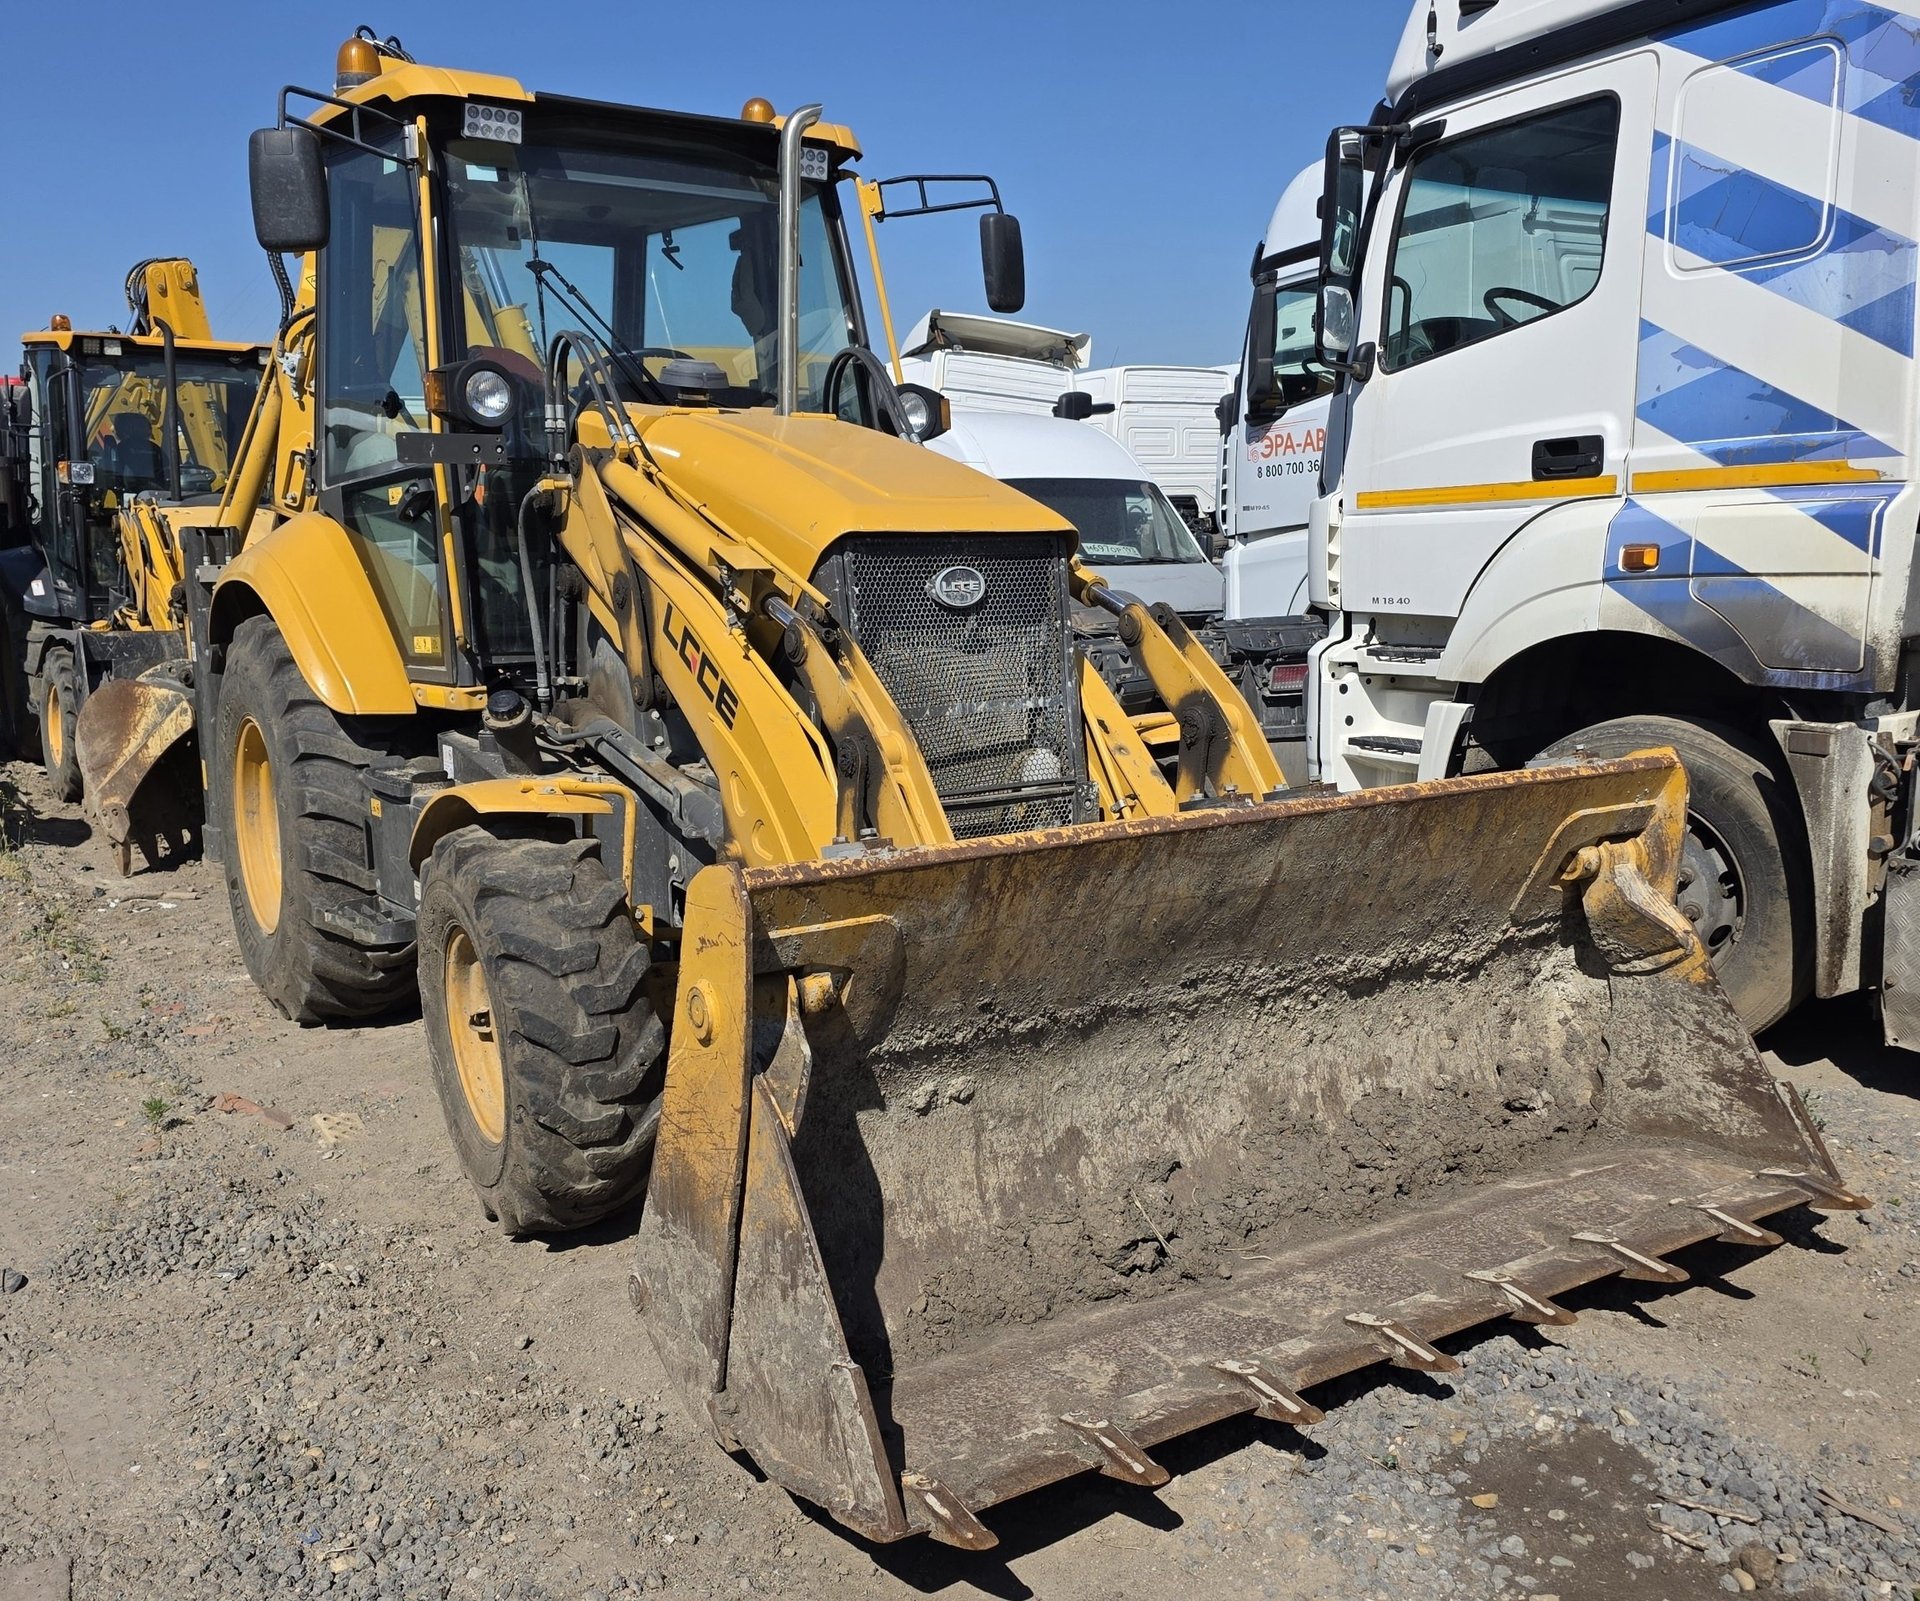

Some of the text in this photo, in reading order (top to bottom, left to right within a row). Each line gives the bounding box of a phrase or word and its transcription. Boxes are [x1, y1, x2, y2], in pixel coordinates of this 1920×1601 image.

[1257, 459, 1320, 479] 8 800 700 36
[662, 602, 739, 731] LGCE
